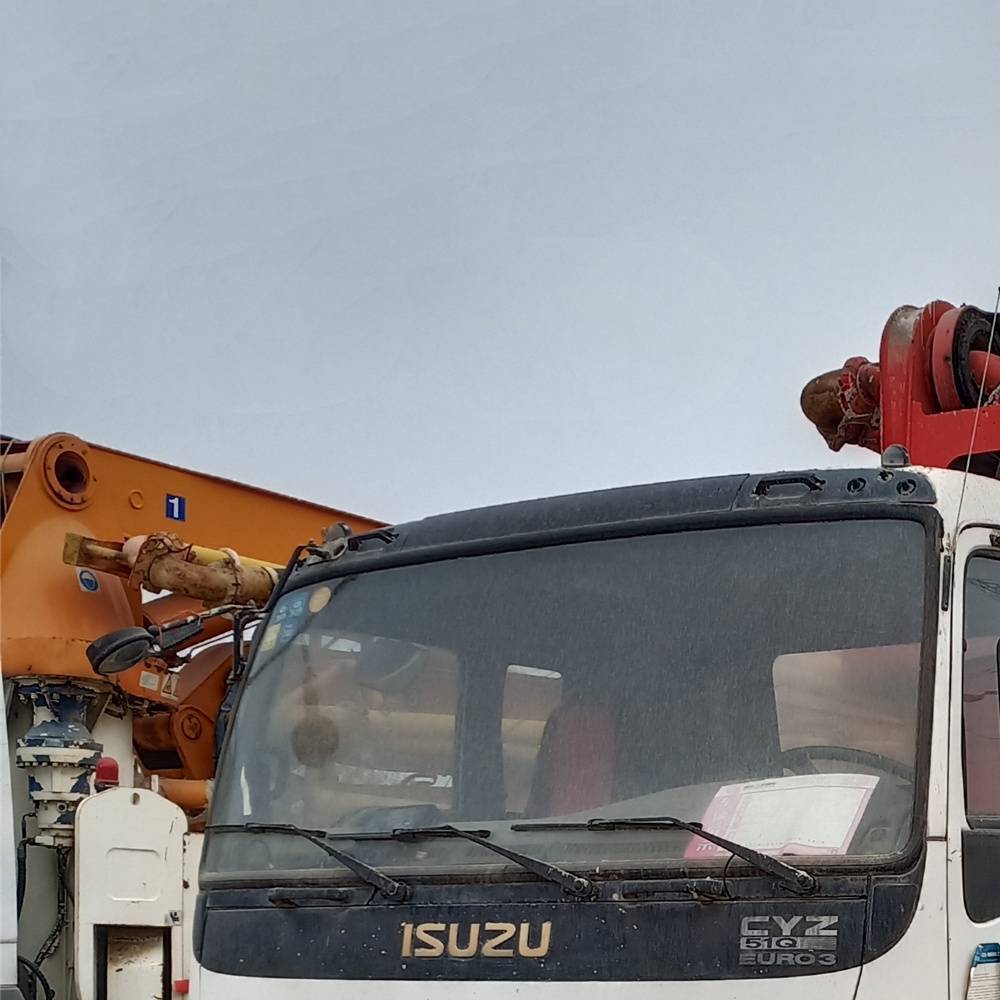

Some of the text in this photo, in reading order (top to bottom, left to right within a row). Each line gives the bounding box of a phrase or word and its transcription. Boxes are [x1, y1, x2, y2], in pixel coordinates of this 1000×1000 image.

[168, 497, 179, 518] 1
[740, 915, 839, 936] CYZ
[401, 921, 553, 958] ISUZU
